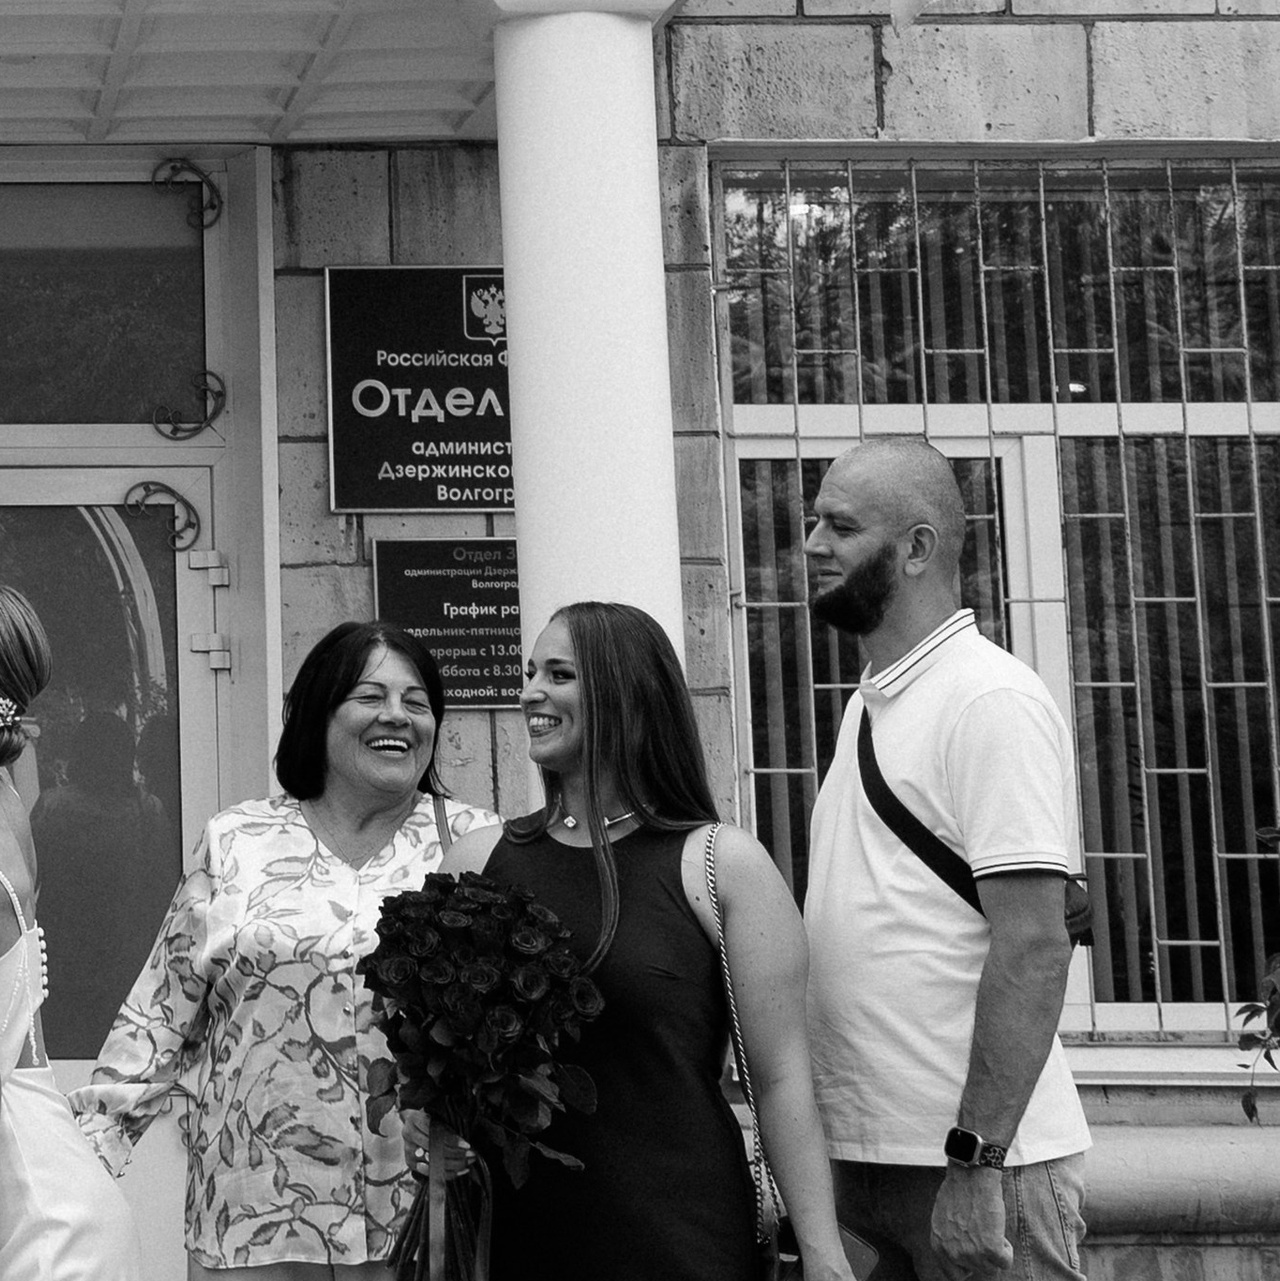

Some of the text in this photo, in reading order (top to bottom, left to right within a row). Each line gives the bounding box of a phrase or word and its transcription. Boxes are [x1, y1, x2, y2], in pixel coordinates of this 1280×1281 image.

[376, 349, 494, 367] Российская
[351, 379, 505, 423] Отдел
[377, 461, 514, 481] Дзержинско
[453, 547, 501, 562] Отдел
[404, 566, 518, 577] администрации Дзерж
[443, 602, 497, 619] График
[403, 627, 522, 638] едельник-пятница
[479, 647, 487, 657] с
[438, 663, 522, 677] ббота с 8.30
[443, 685, 499, 699] ходной:
